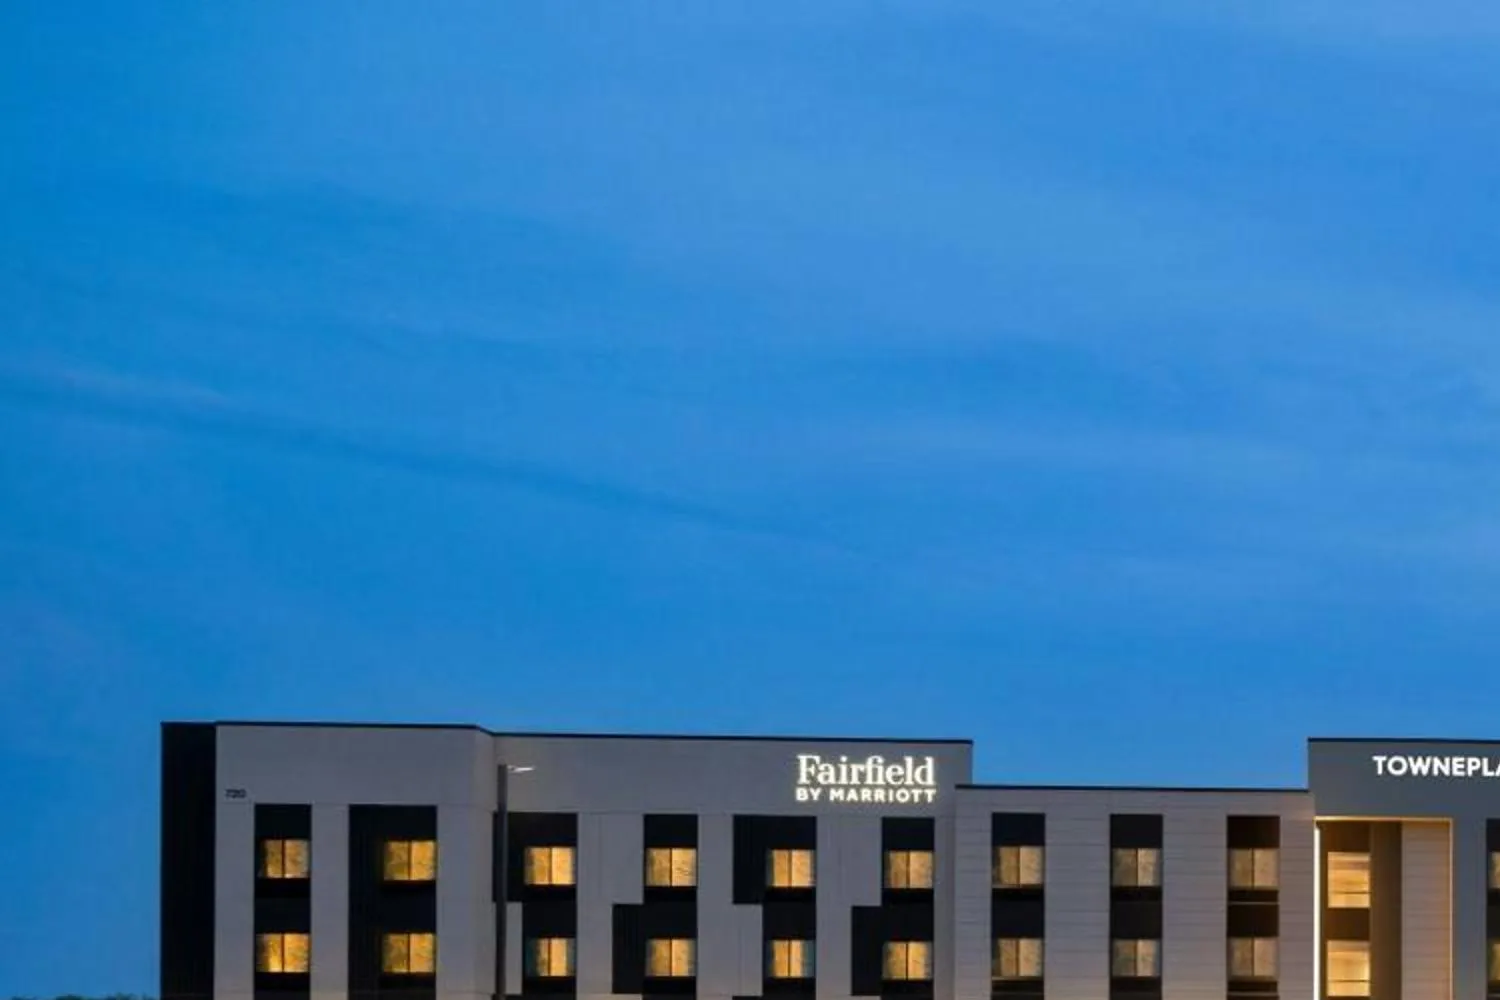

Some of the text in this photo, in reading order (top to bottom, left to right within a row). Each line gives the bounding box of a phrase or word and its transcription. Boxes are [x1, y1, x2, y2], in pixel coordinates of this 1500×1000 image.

[797, 754, 935, 785] Fairfield
[796, 787, 936, 803] BY MARRIOTT
